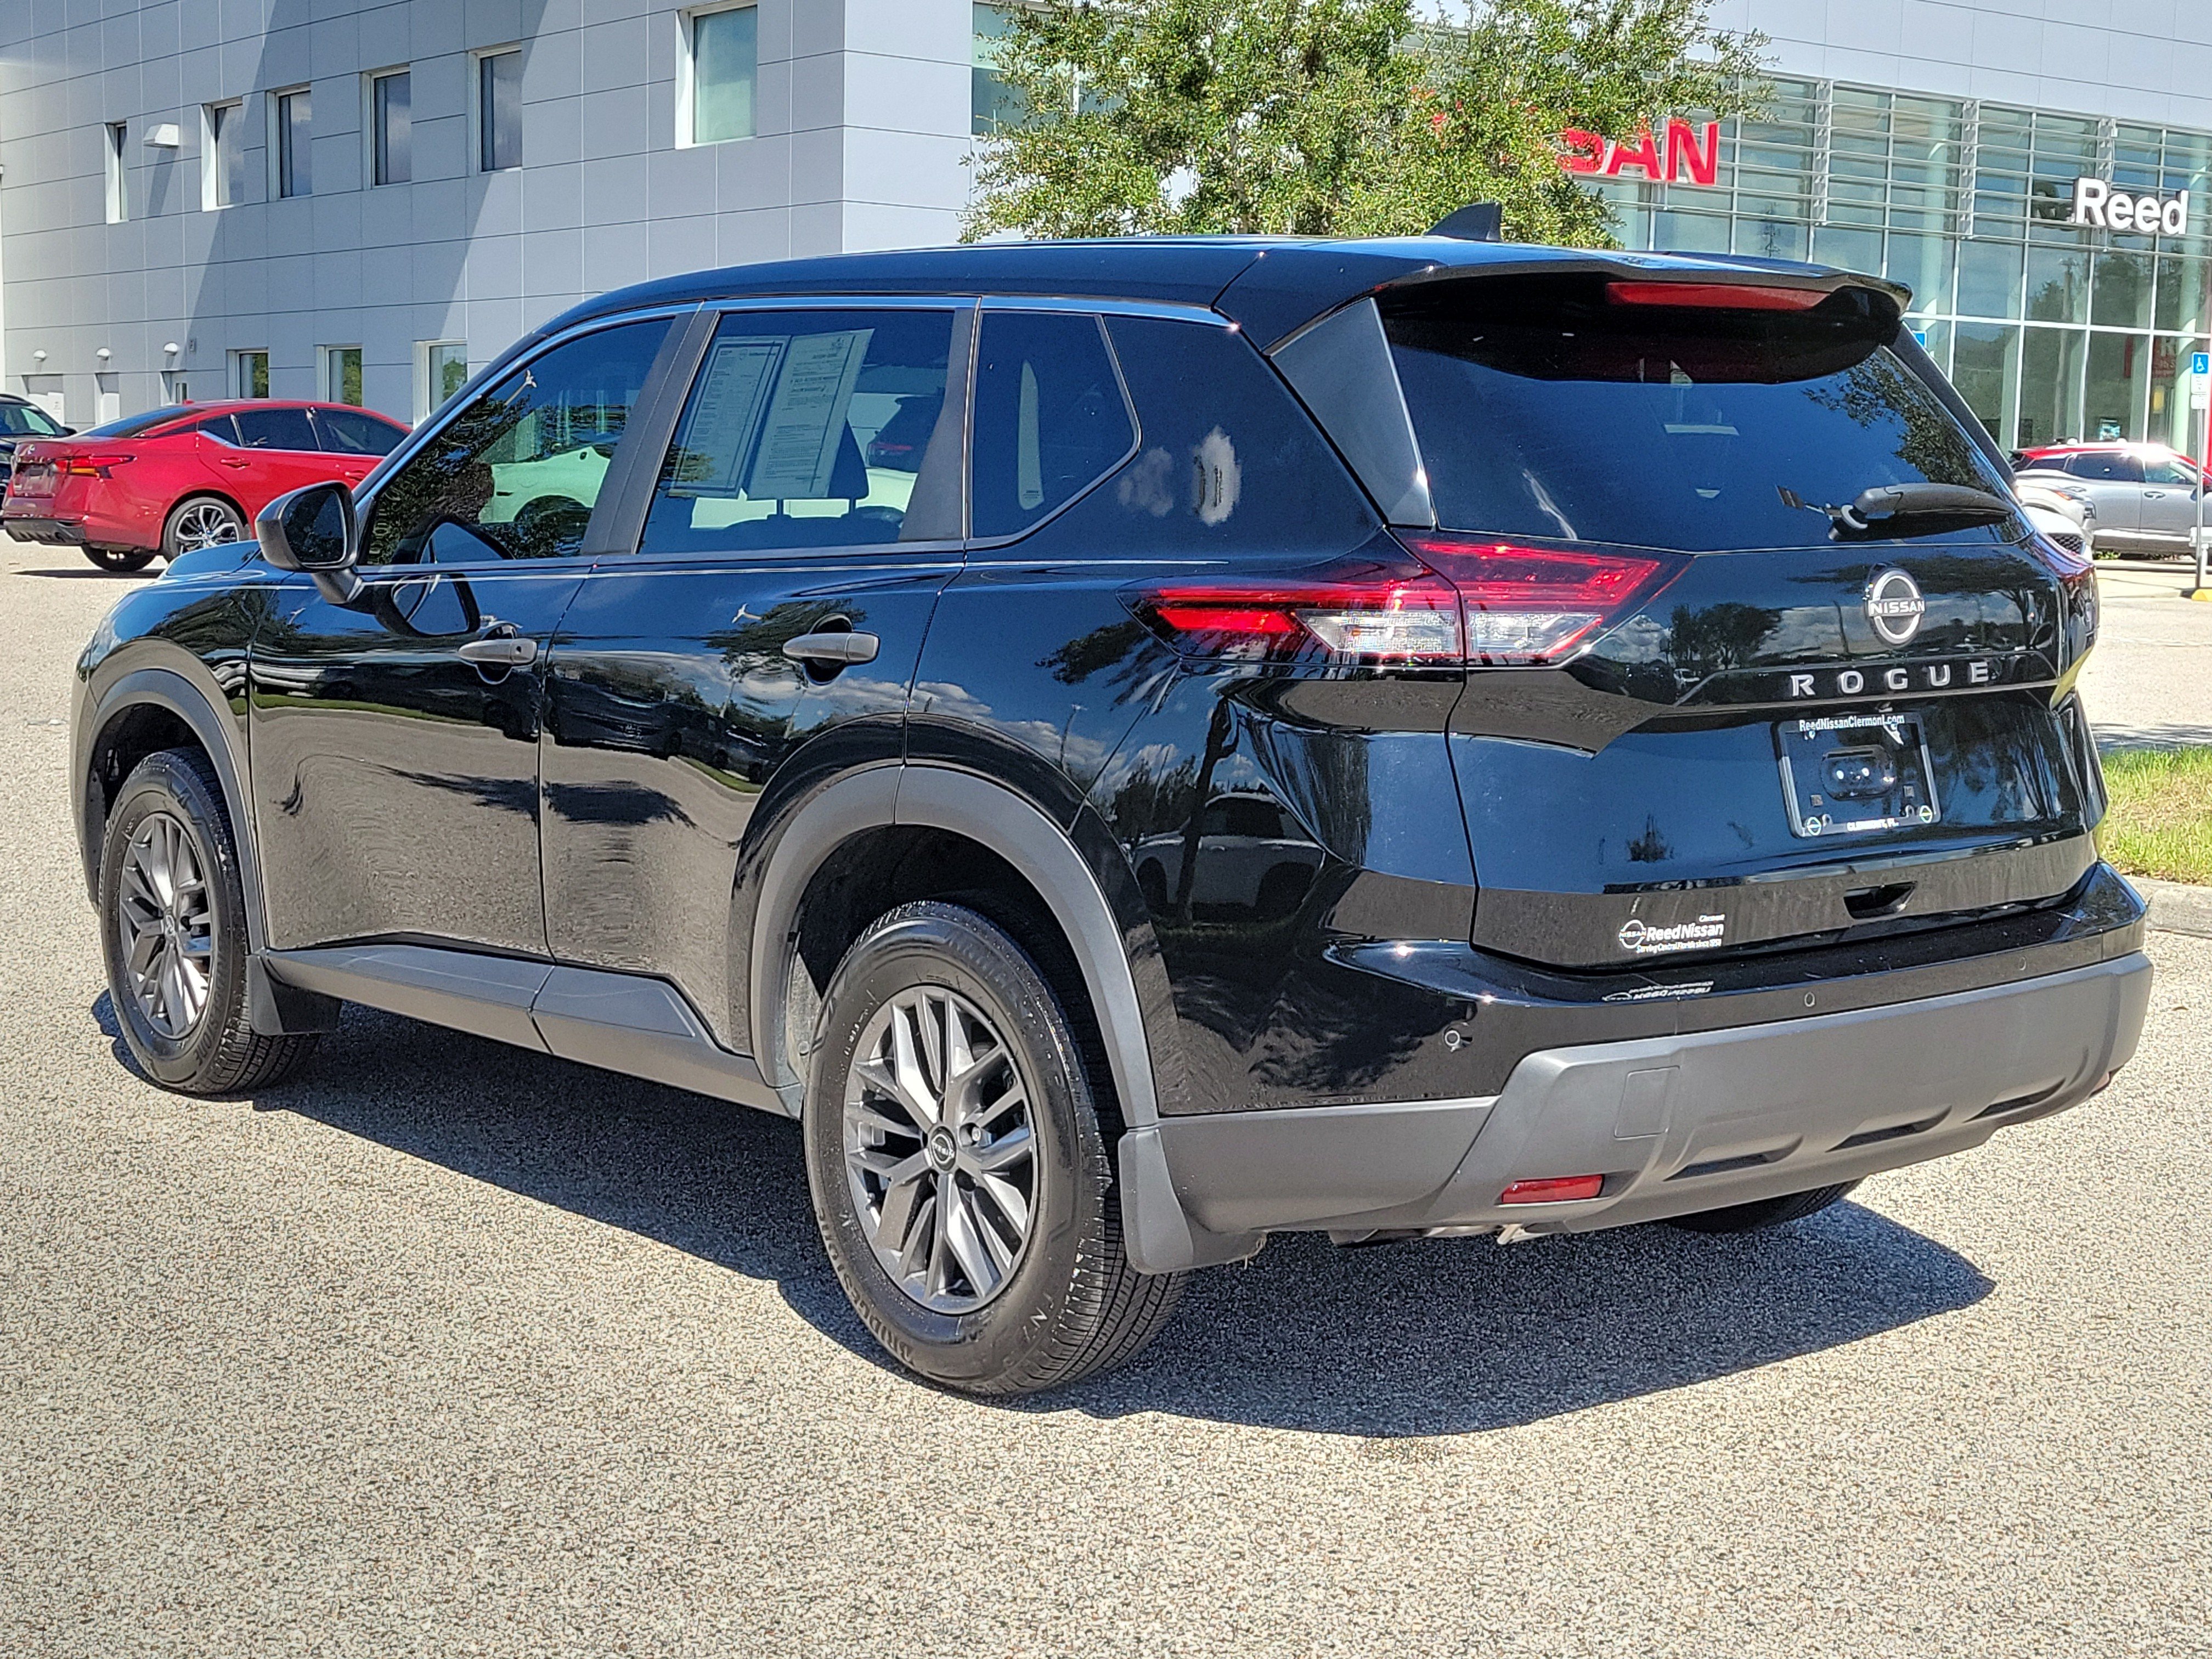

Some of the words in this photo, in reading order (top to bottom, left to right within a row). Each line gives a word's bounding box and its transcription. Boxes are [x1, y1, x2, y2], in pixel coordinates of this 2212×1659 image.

[1555, 117, 1720, 185] SAN
[2074, 177, 2190, 235] Reed
[1869, 600, 1926, 617] NISSAN
[1790, 662, 1989, 697] ROGUE
